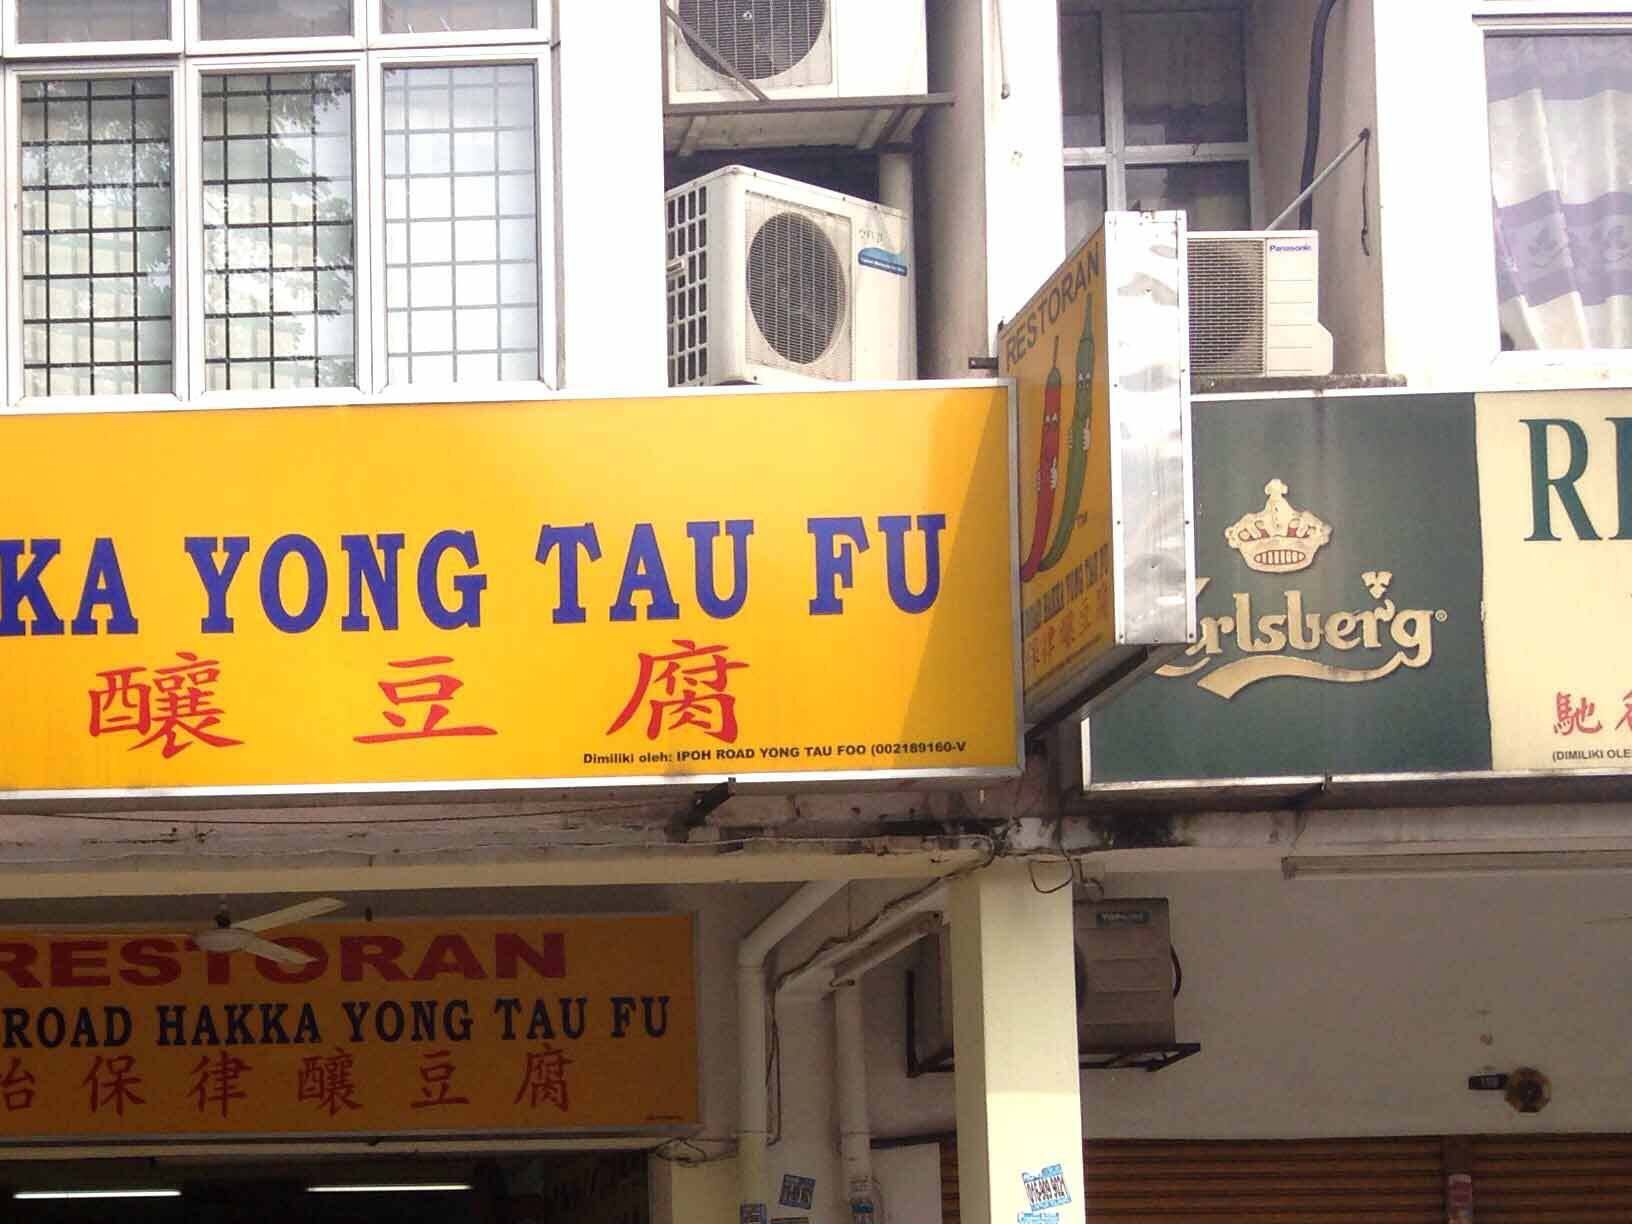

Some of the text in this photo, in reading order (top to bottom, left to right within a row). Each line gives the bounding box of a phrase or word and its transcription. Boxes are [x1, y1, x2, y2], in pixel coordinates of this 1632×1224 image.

[1005, 241, 1099, 373] RESTORAN
[184, 529, 488, 635] YONG
[534, 518, 755, 625] TAU
[806, 512, 947, 616] FU
[583, 751, 634, 765] Dimiliki
[639, 750, 673, 764] oleh:
[676, 749, 712, 762] IPOH
[716, 747, 755, 761] ROAD
[759, 746, 800, 760] YONG
[804, 745, 833, 758] TAU
[837, 744, 866, 757] FOO
[2, 1005, 133, 1049] ROAD
[155, 1001, 322, 1047] HAKKA
[346, 999, 475, 1043] YONG
[494, 997, 588, 1042] TAU
[610, 995, 672, 1039] FU
